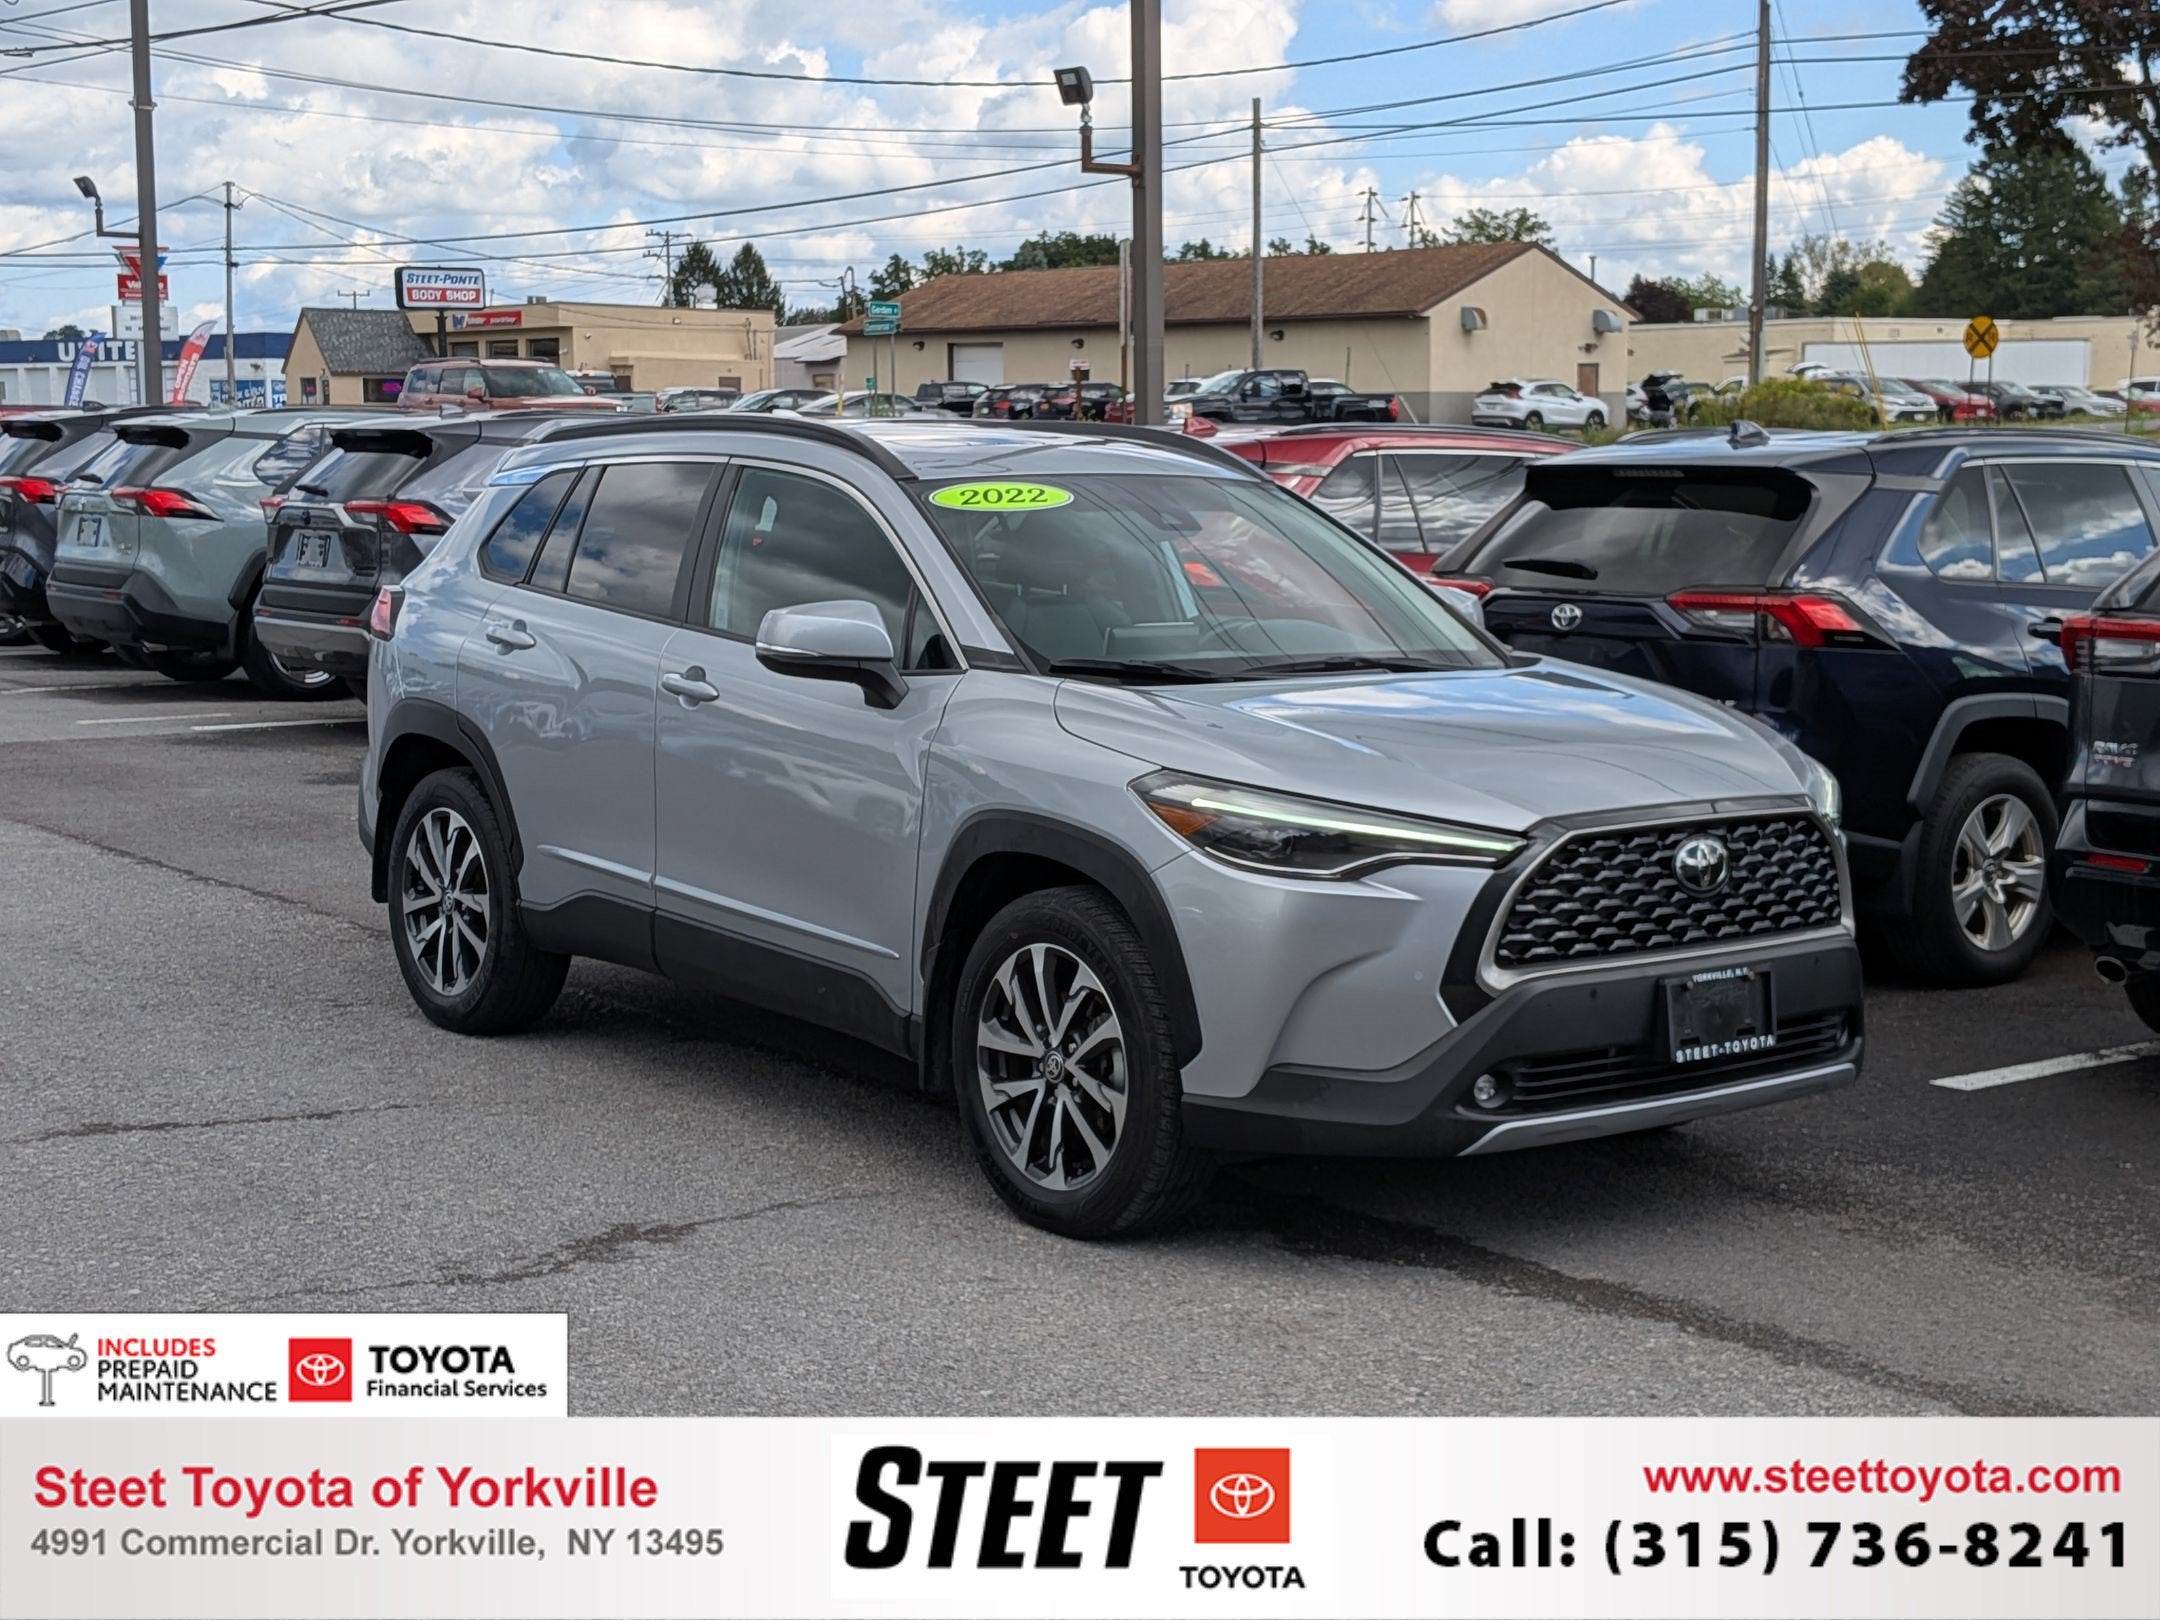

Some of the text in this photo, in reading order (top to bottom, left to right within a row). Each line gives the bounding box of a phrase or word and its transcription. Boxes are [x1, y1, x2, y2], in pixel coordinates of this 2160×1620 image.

[407, 273, 480, 285] STEET-PONTE
[412, 289, 476, 301] BODY SHOP
[960, 488, 1048, 505] 2022
[1676, 1035, 1774, 1063] STEET-TOYOTA
